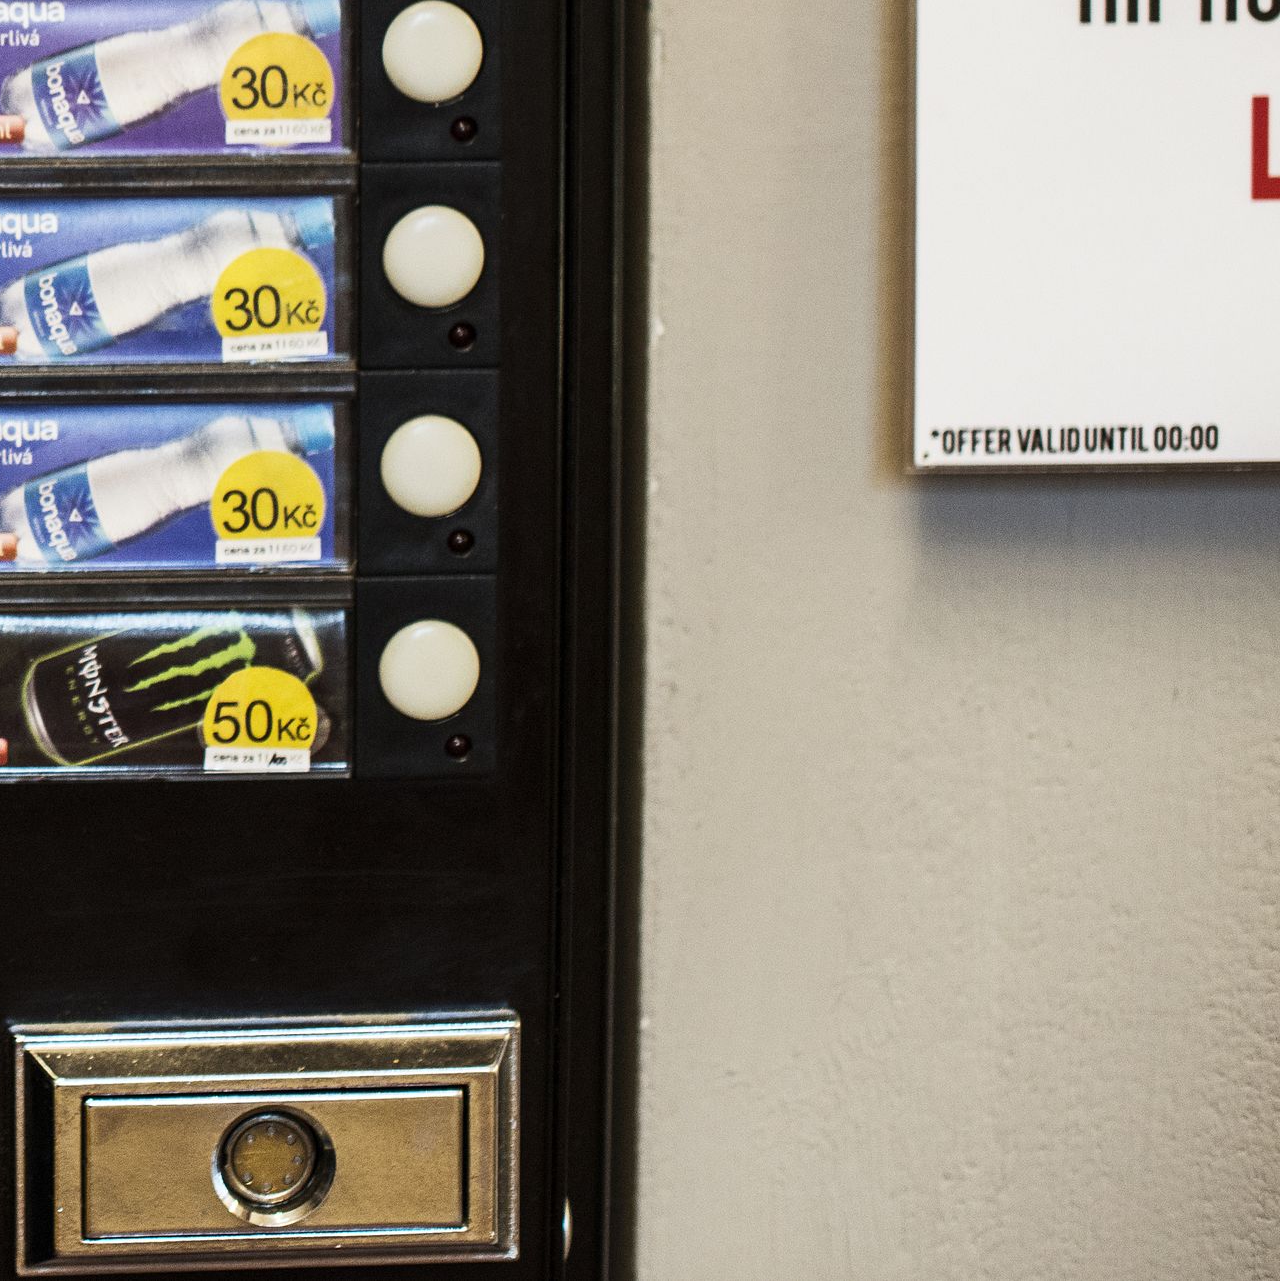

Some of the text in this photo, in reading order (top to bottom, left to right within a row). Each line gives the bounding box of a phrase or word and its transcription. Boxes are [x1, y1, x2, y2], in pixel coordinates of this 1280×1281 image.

[1017, 427, 1081, 454] VALID
[1084, 426, 1149, 453] UNTIL
[78, 644, 130, 748] MONSTER
